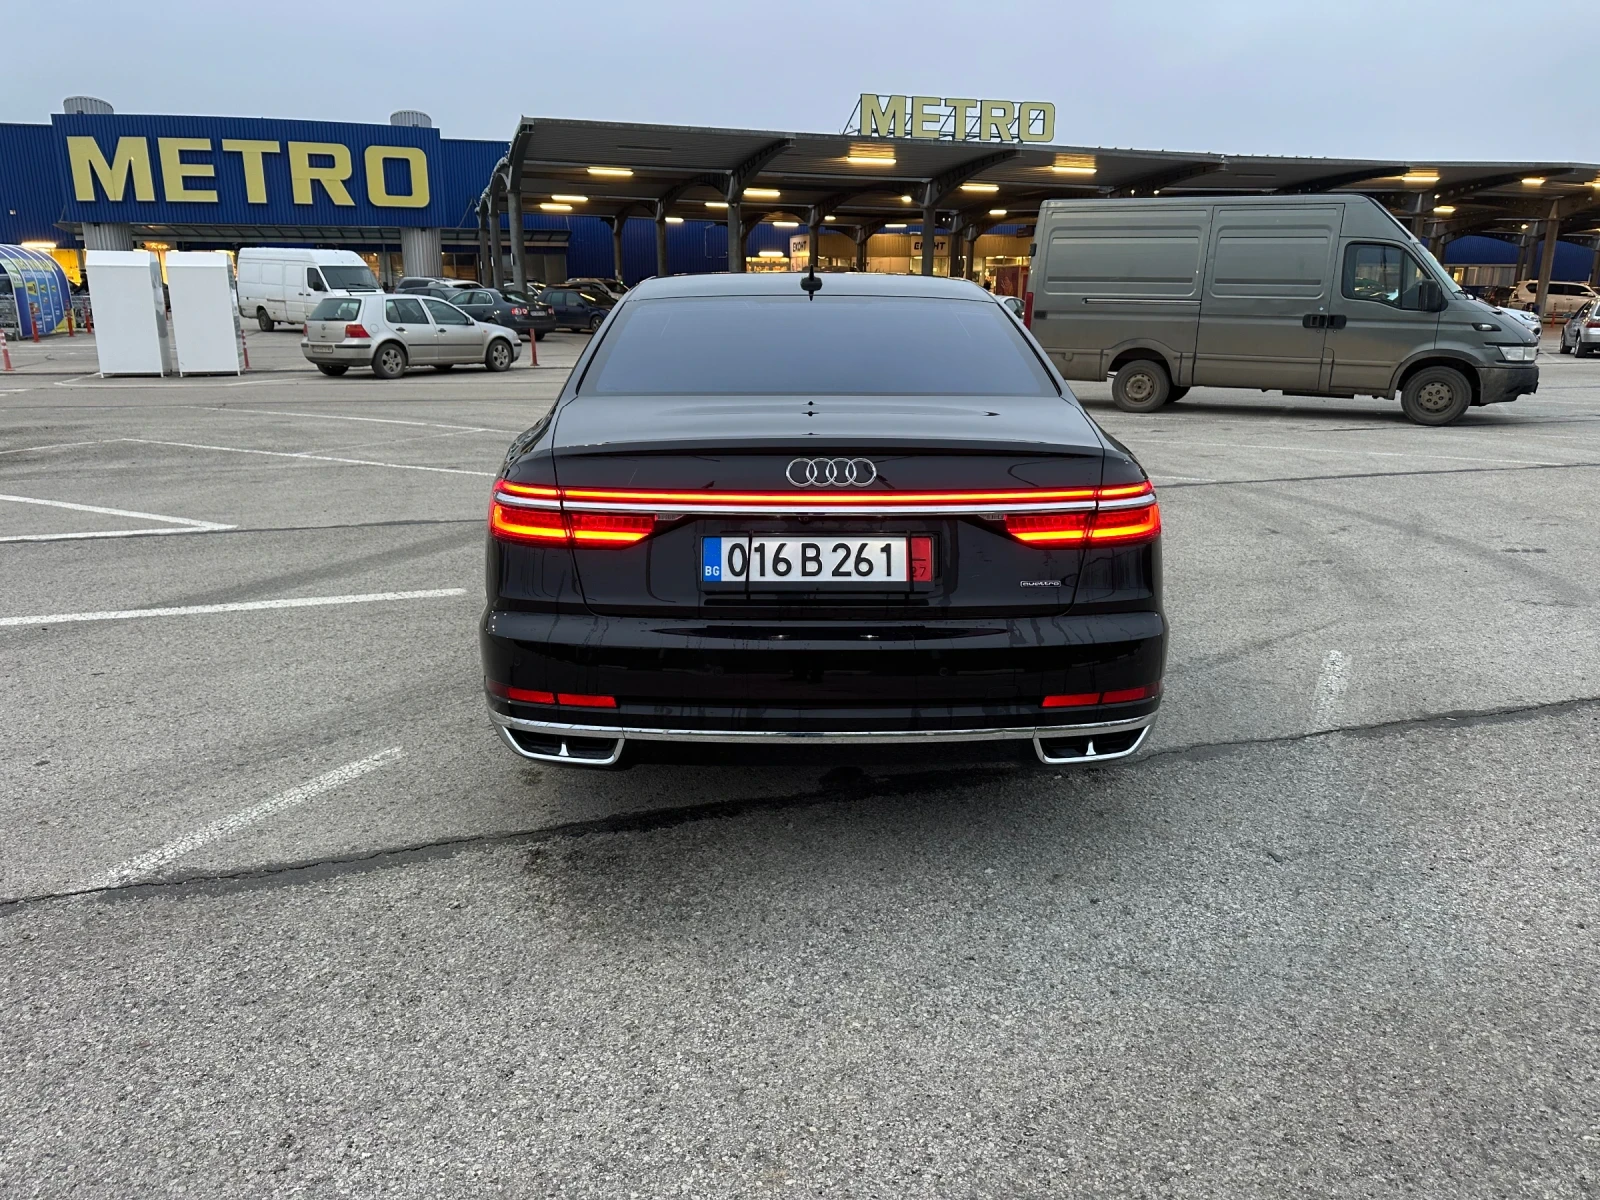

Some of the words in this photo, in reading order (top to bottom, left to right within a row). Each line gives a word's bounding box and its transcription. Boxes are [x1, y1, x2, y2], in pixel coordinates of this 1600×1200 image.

[860, 93, 1055, 142] METRO
[66, 136, 430, 208] METRO
[705, 565, 721, 577] BG
